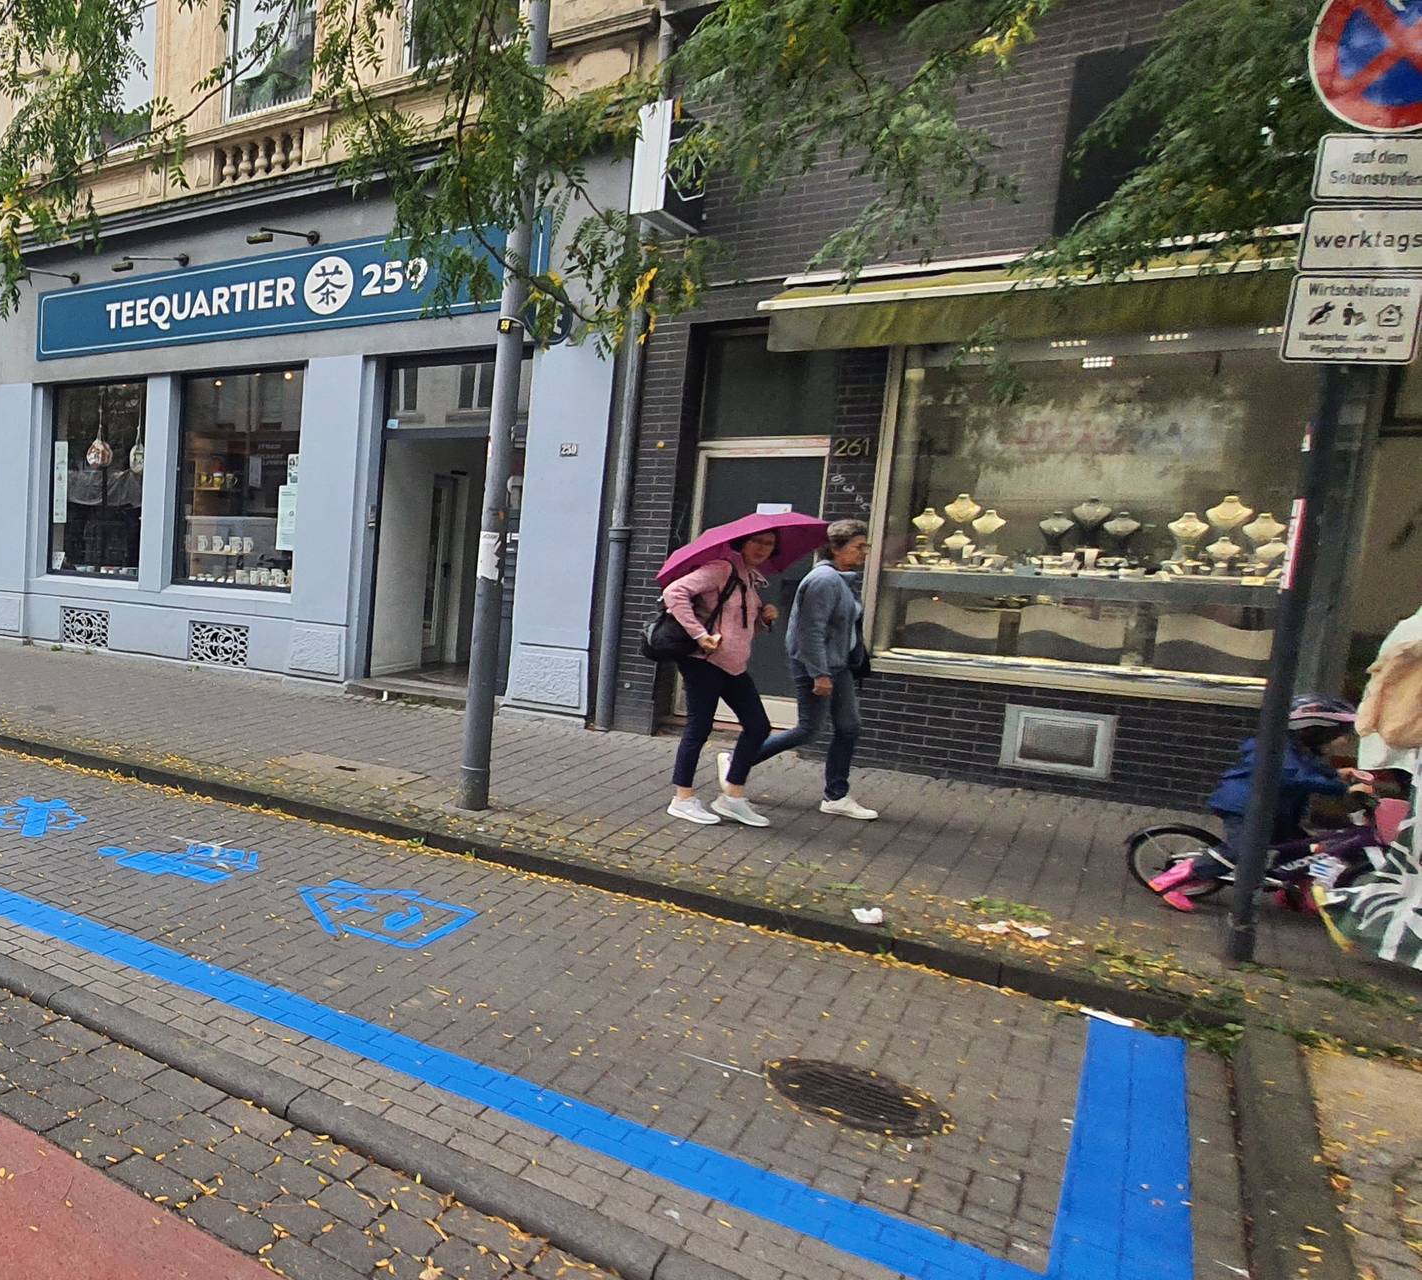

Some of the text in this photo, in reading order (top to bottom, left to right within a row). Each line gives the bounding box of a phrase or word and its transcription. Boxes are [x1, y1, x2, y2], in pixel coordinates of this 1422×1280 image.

[1352, 149, 1408, 164] auf dem
[1313, 230, 1422, 253] werktags
[106, 257, 428, 331] TEEQUARTIER 茶 259
[833, 437, 870, 457] 261
